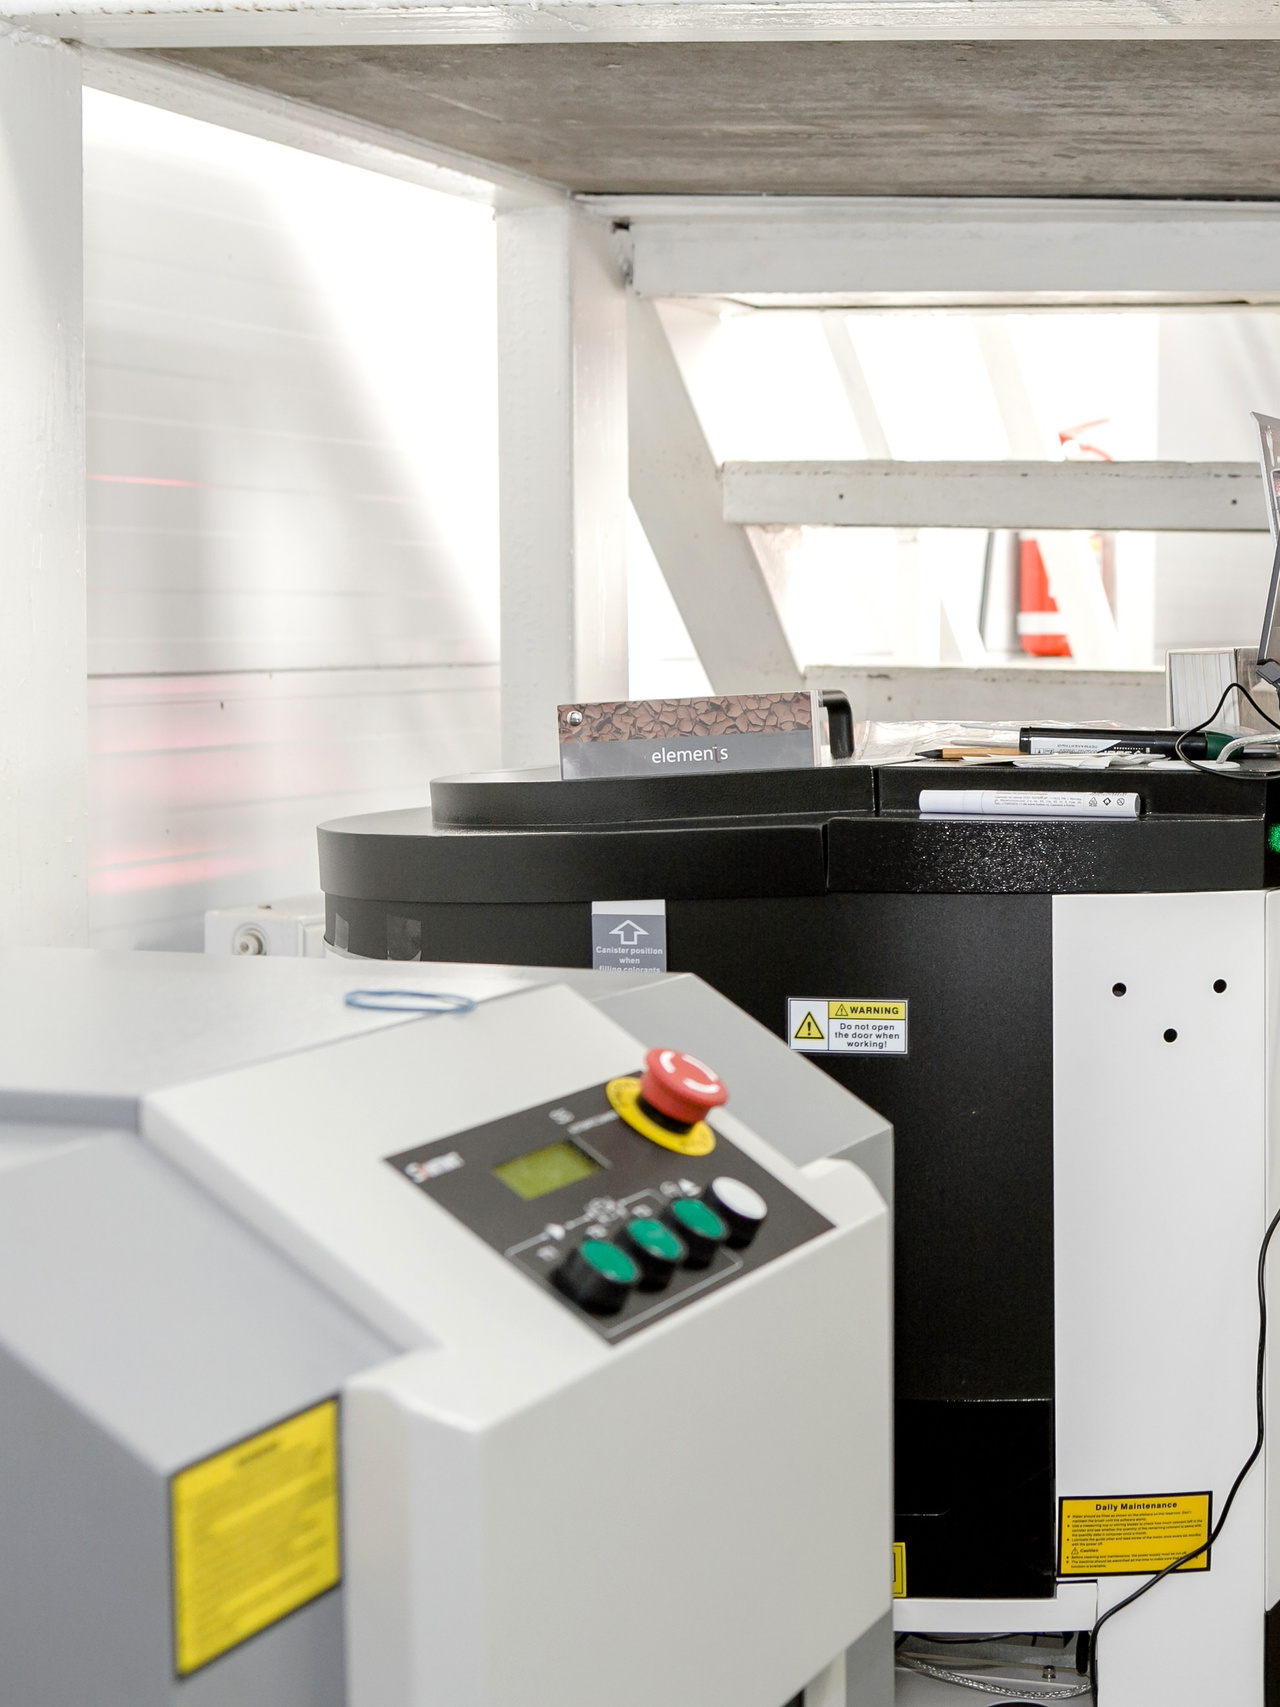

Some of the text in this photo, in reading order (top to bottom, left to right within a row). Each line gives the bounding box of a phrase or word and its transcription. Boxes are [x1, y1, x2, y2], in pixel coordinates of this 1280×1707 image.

[596, 946, 663, 955] Canister position
[849, 1006, 899, 1015] WARNING
[840, 1022, 852, 1030] Do
[847, 1041, 887, 1049] working!
[1095, 1502, 1177, 1512] Daily Maintenance
